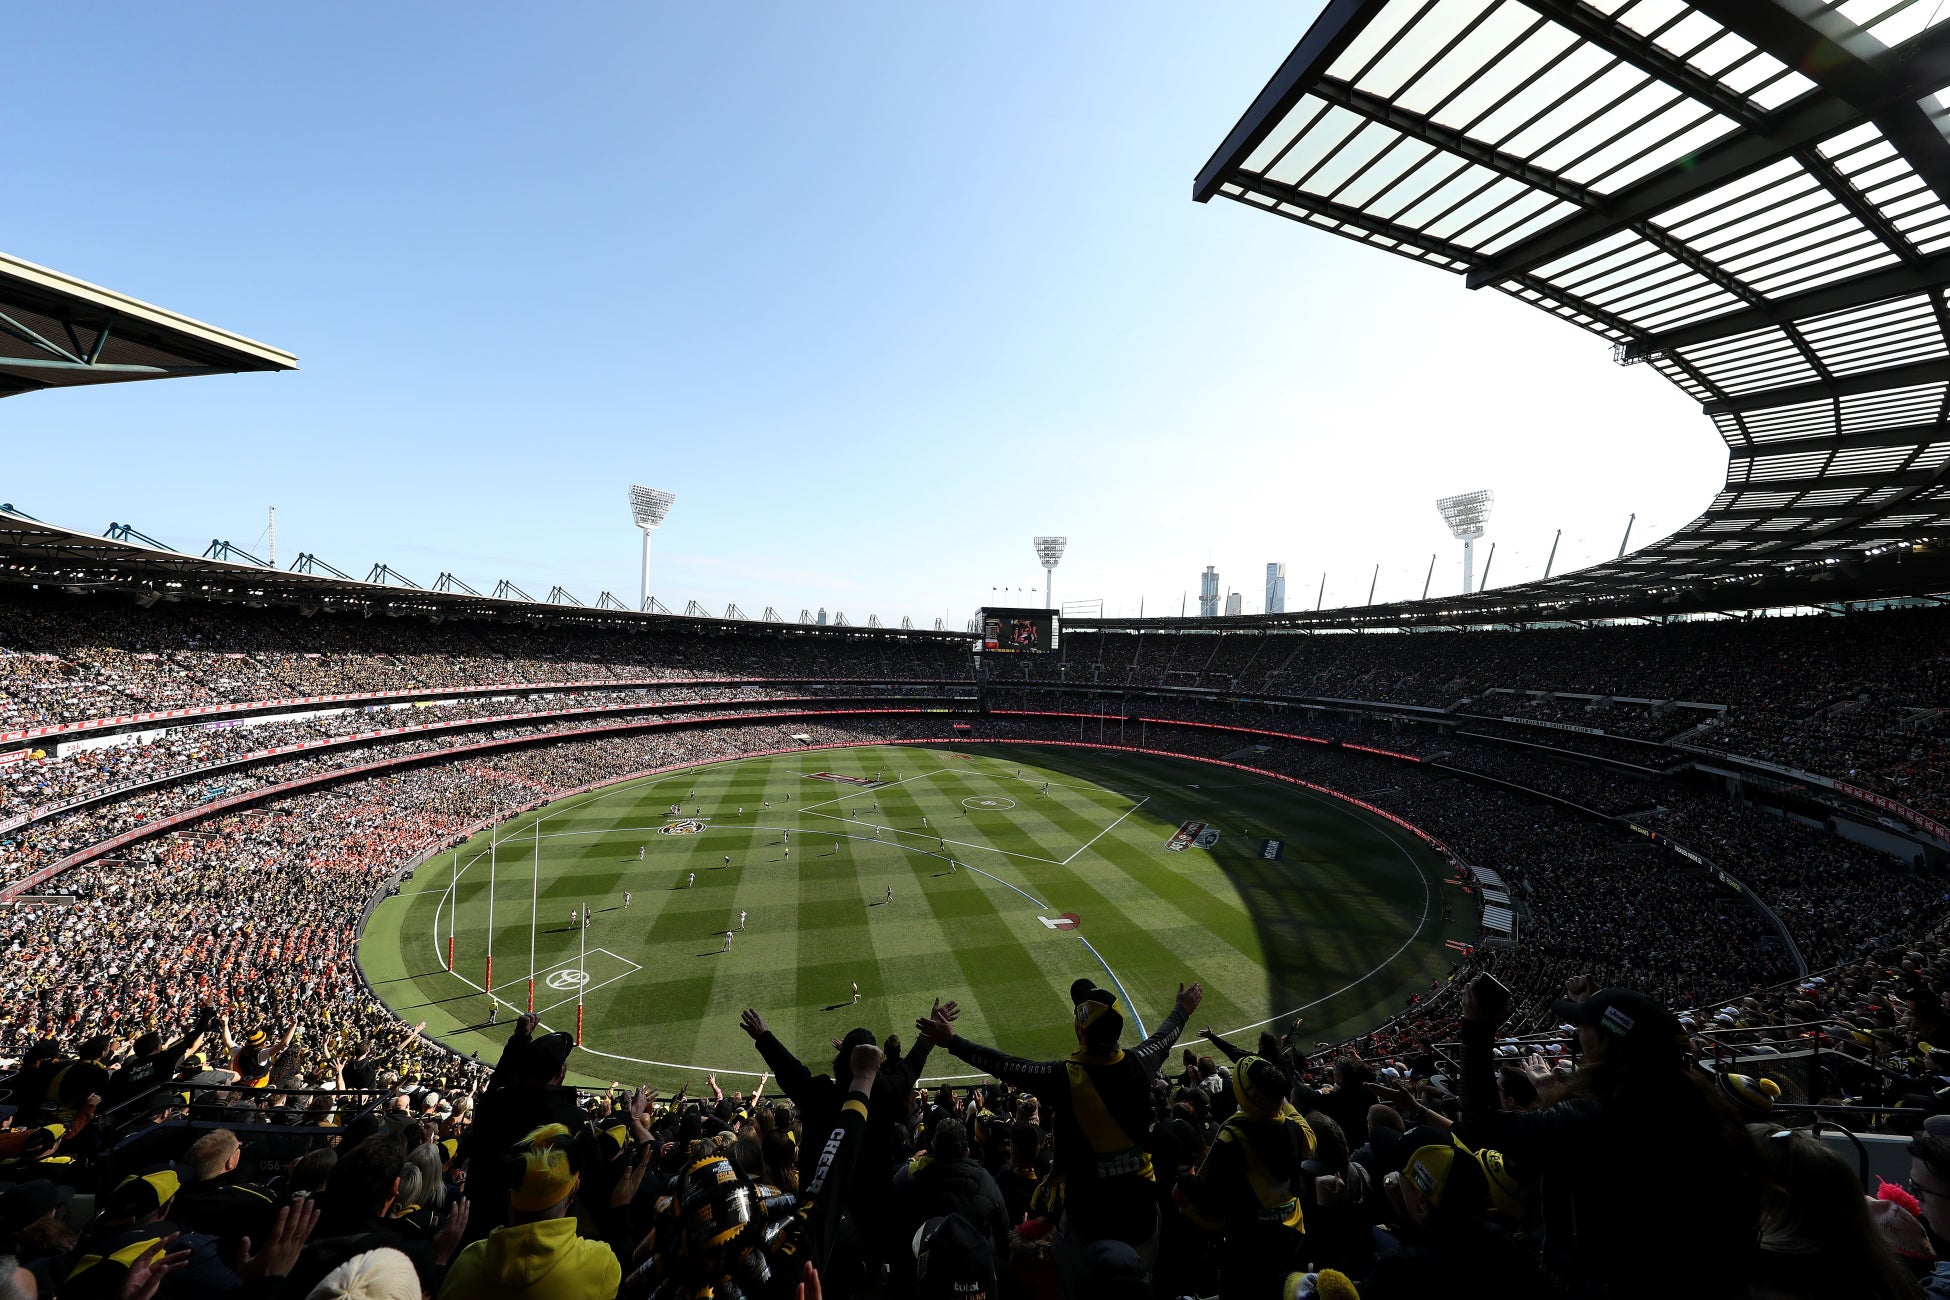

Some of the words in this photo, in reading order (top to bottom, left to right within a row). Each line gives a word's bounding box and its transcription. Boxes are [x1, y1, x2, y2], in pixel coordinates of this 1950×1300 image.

[66, 742, 84, 752] zak!
[1610, 1010, 1630, 1027] Jeep
[1003, 1061, 1052, 1075] BOROUGHS
[805, 1128, 845, 1195] CHEER
[1097, 1152, 1140, 1178] nib
[953, 1281, 980, 1292] total
